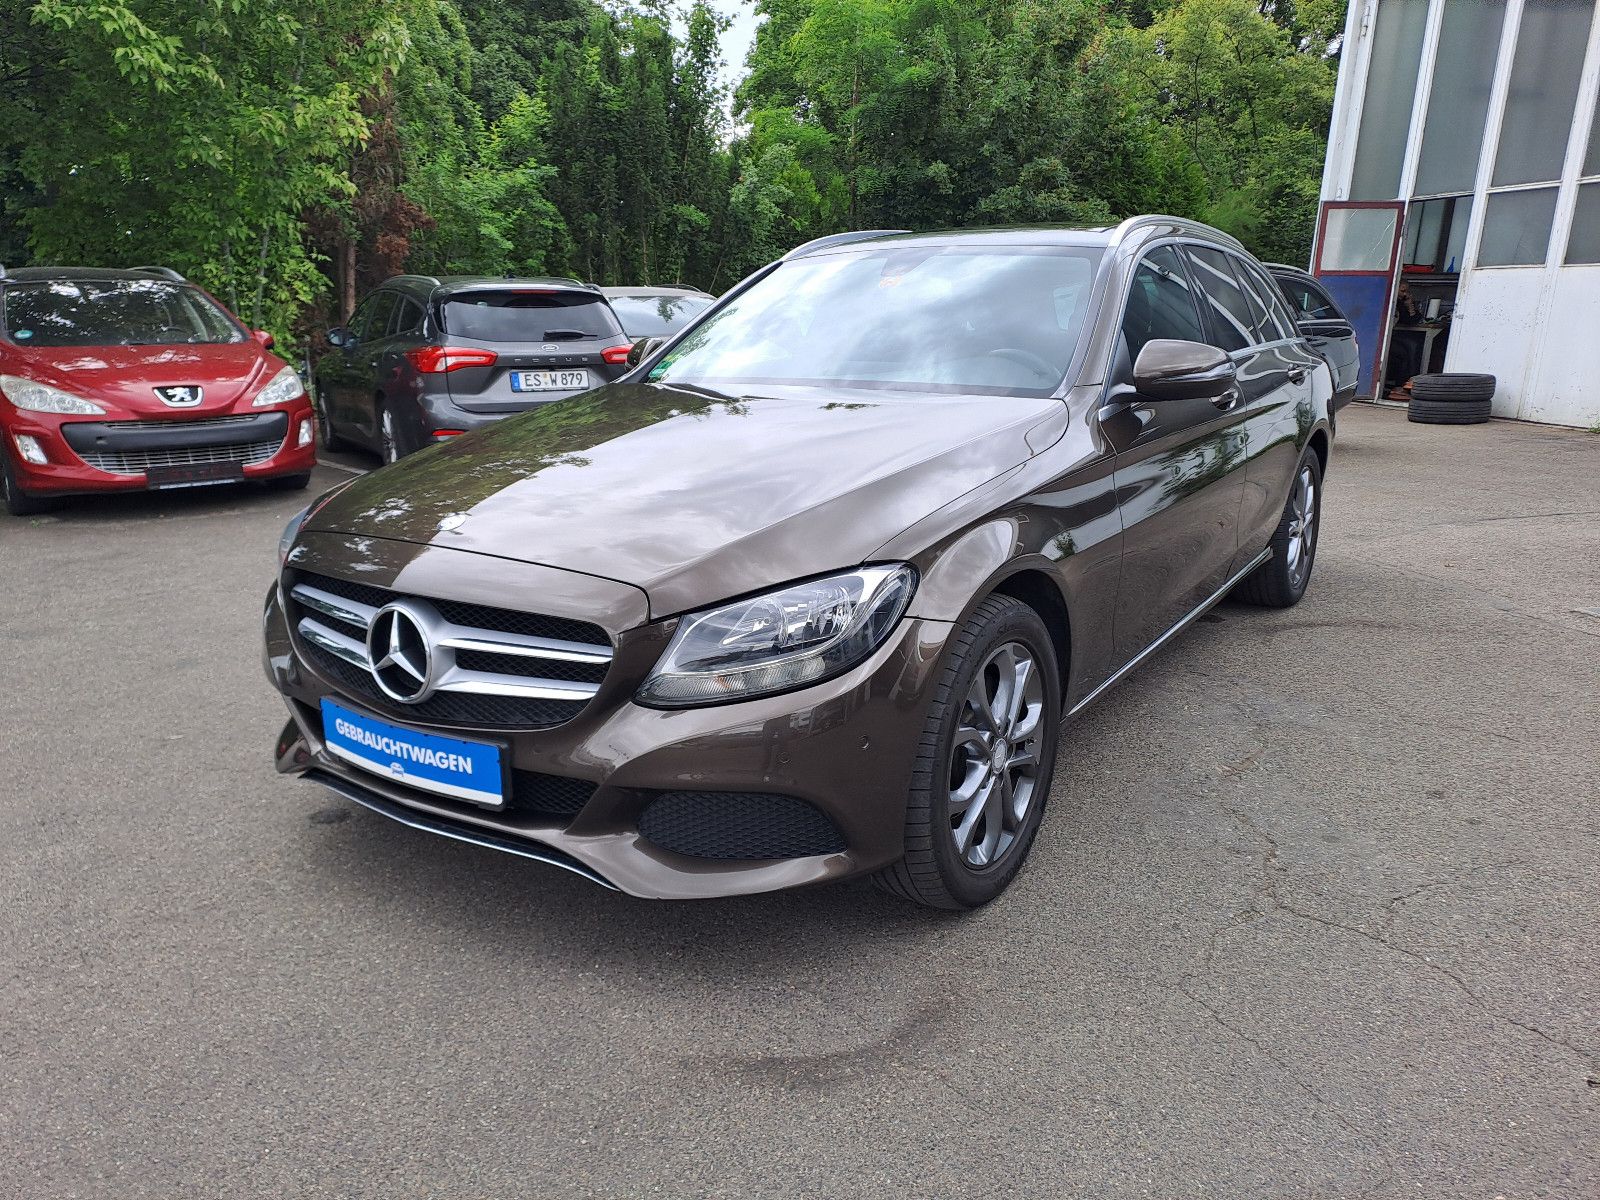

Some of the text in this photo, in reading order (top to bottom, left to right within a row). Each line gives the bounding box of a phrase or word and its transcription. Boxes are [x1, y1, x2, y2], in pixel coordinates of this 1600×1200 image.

[524, 373, 583, 387] ES W 879
[335, 718, 473, 775] GEBRAUCHTWAGEN
